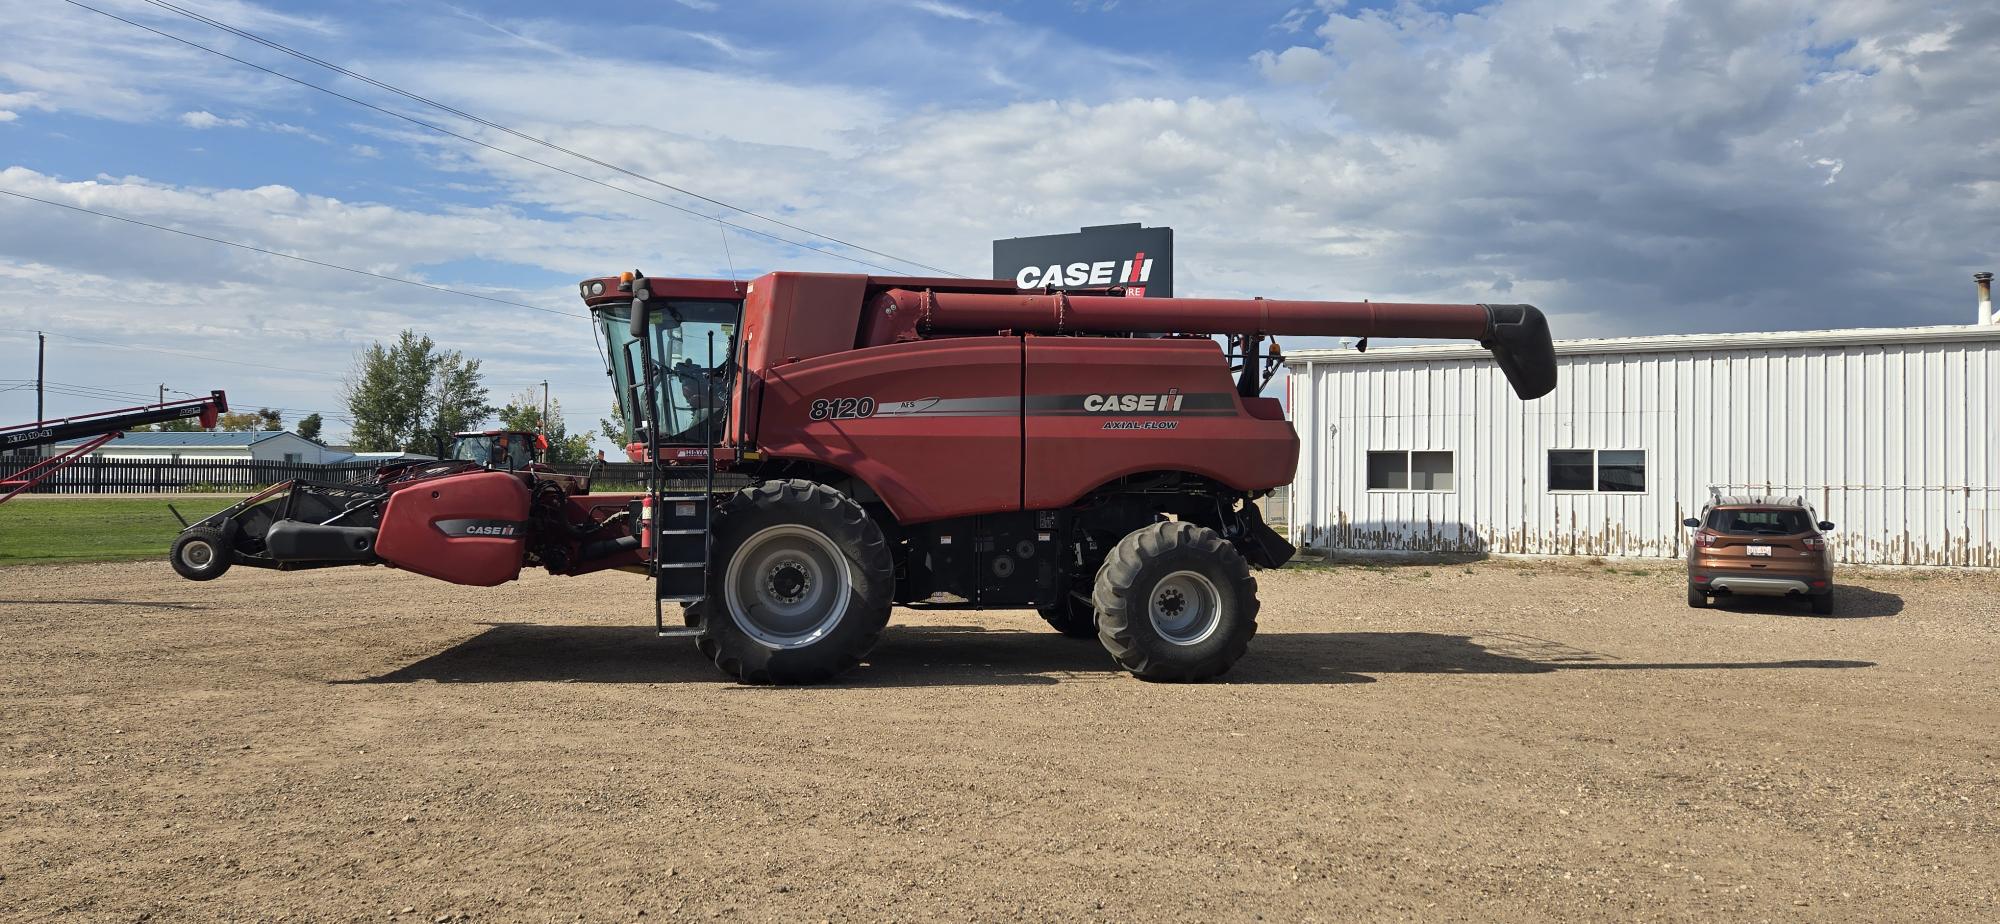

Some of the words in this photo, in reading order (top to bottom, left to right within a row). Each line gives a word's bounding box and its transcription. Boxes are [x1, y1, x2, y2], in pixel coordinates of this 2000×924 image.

[1016, 260, 1116, 290] CASE
[1119, 252, 1153, 283] IH
[809, 396, 875, 420] 8120
[1084, 394, 1157, 412] CASE
[1158, 388, 1184, 412] IH
[1102, 421, 1178, 430] AXIAL-FLOW
[466, 526, 501, 535] CASE
